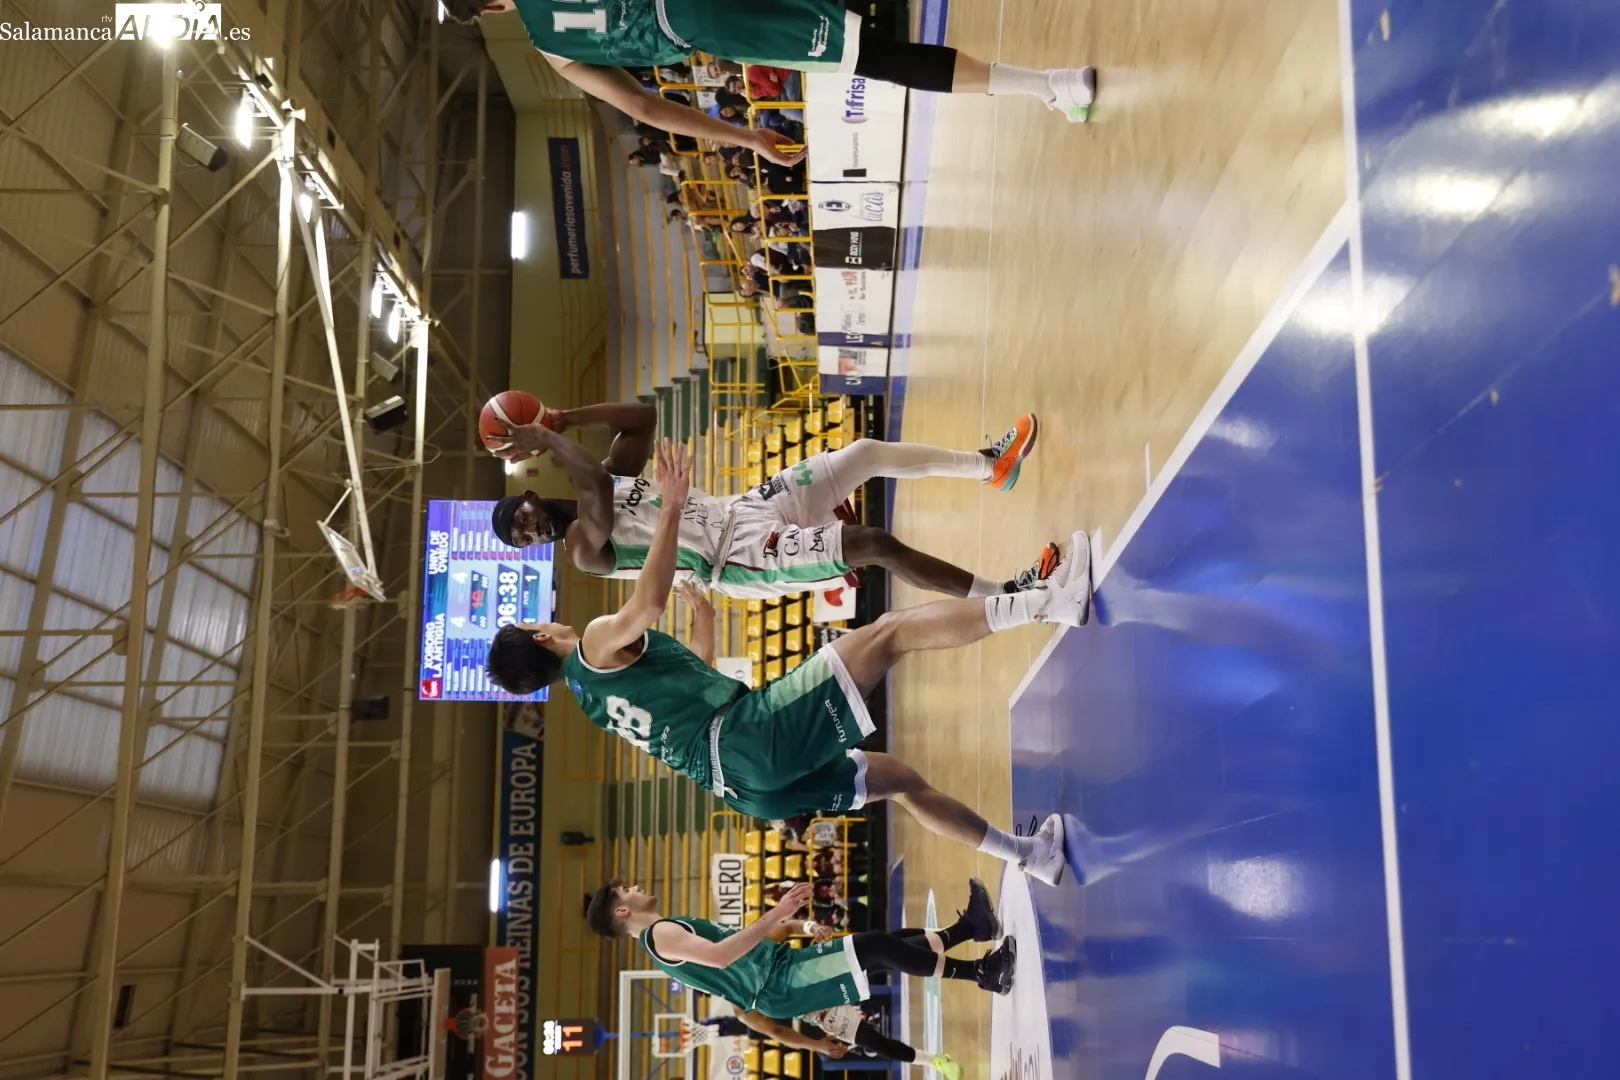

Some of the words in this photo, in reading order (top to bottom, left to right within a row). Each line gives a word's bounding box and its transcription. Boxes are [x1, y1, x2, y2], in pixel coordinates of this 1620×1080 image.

[430, 530, 440, 545] DE
[438, 531, 449, 573] OVIEDO
[452, 572, 469, 584] 4
[497, 571, 518, 627] 06:38
[434, 613, 446, 662] ANTIGUA
[450, 616, 467, 628] 4
[424, 622, 436, 670] XOBORG
[432, 663, 443, 678] LA
[509, 742, 537, 836] EUROPA
[508, 843, 534, 874] DE
[485, 959, 516, 1077] GACETA
[562, 1025, 583, 1052] 11
